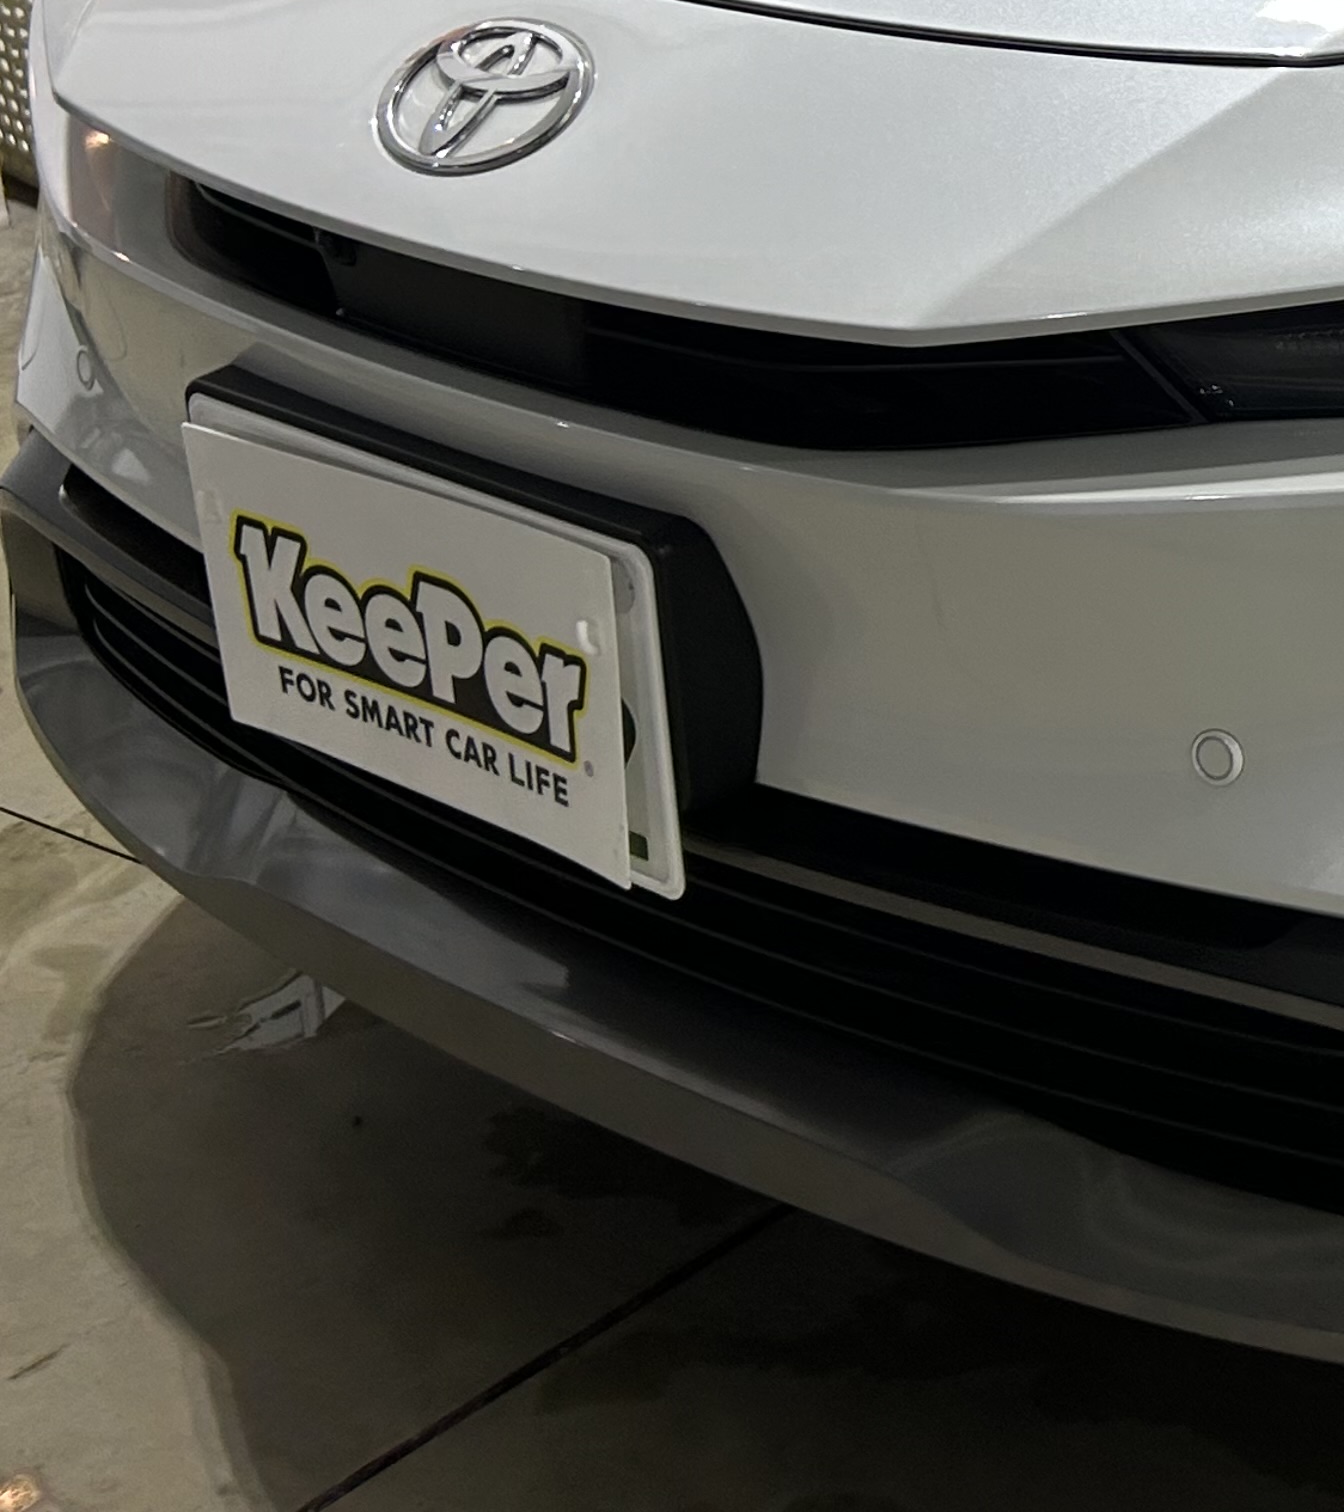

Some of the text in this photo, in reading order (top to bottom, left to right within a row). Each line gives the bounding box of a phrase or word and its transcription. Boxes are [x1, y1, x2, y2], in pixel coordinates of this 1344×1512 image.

[233, 514, 588, 764] KeePer
[277, 666, 570, 808] FOR SMART CAR LIFE
